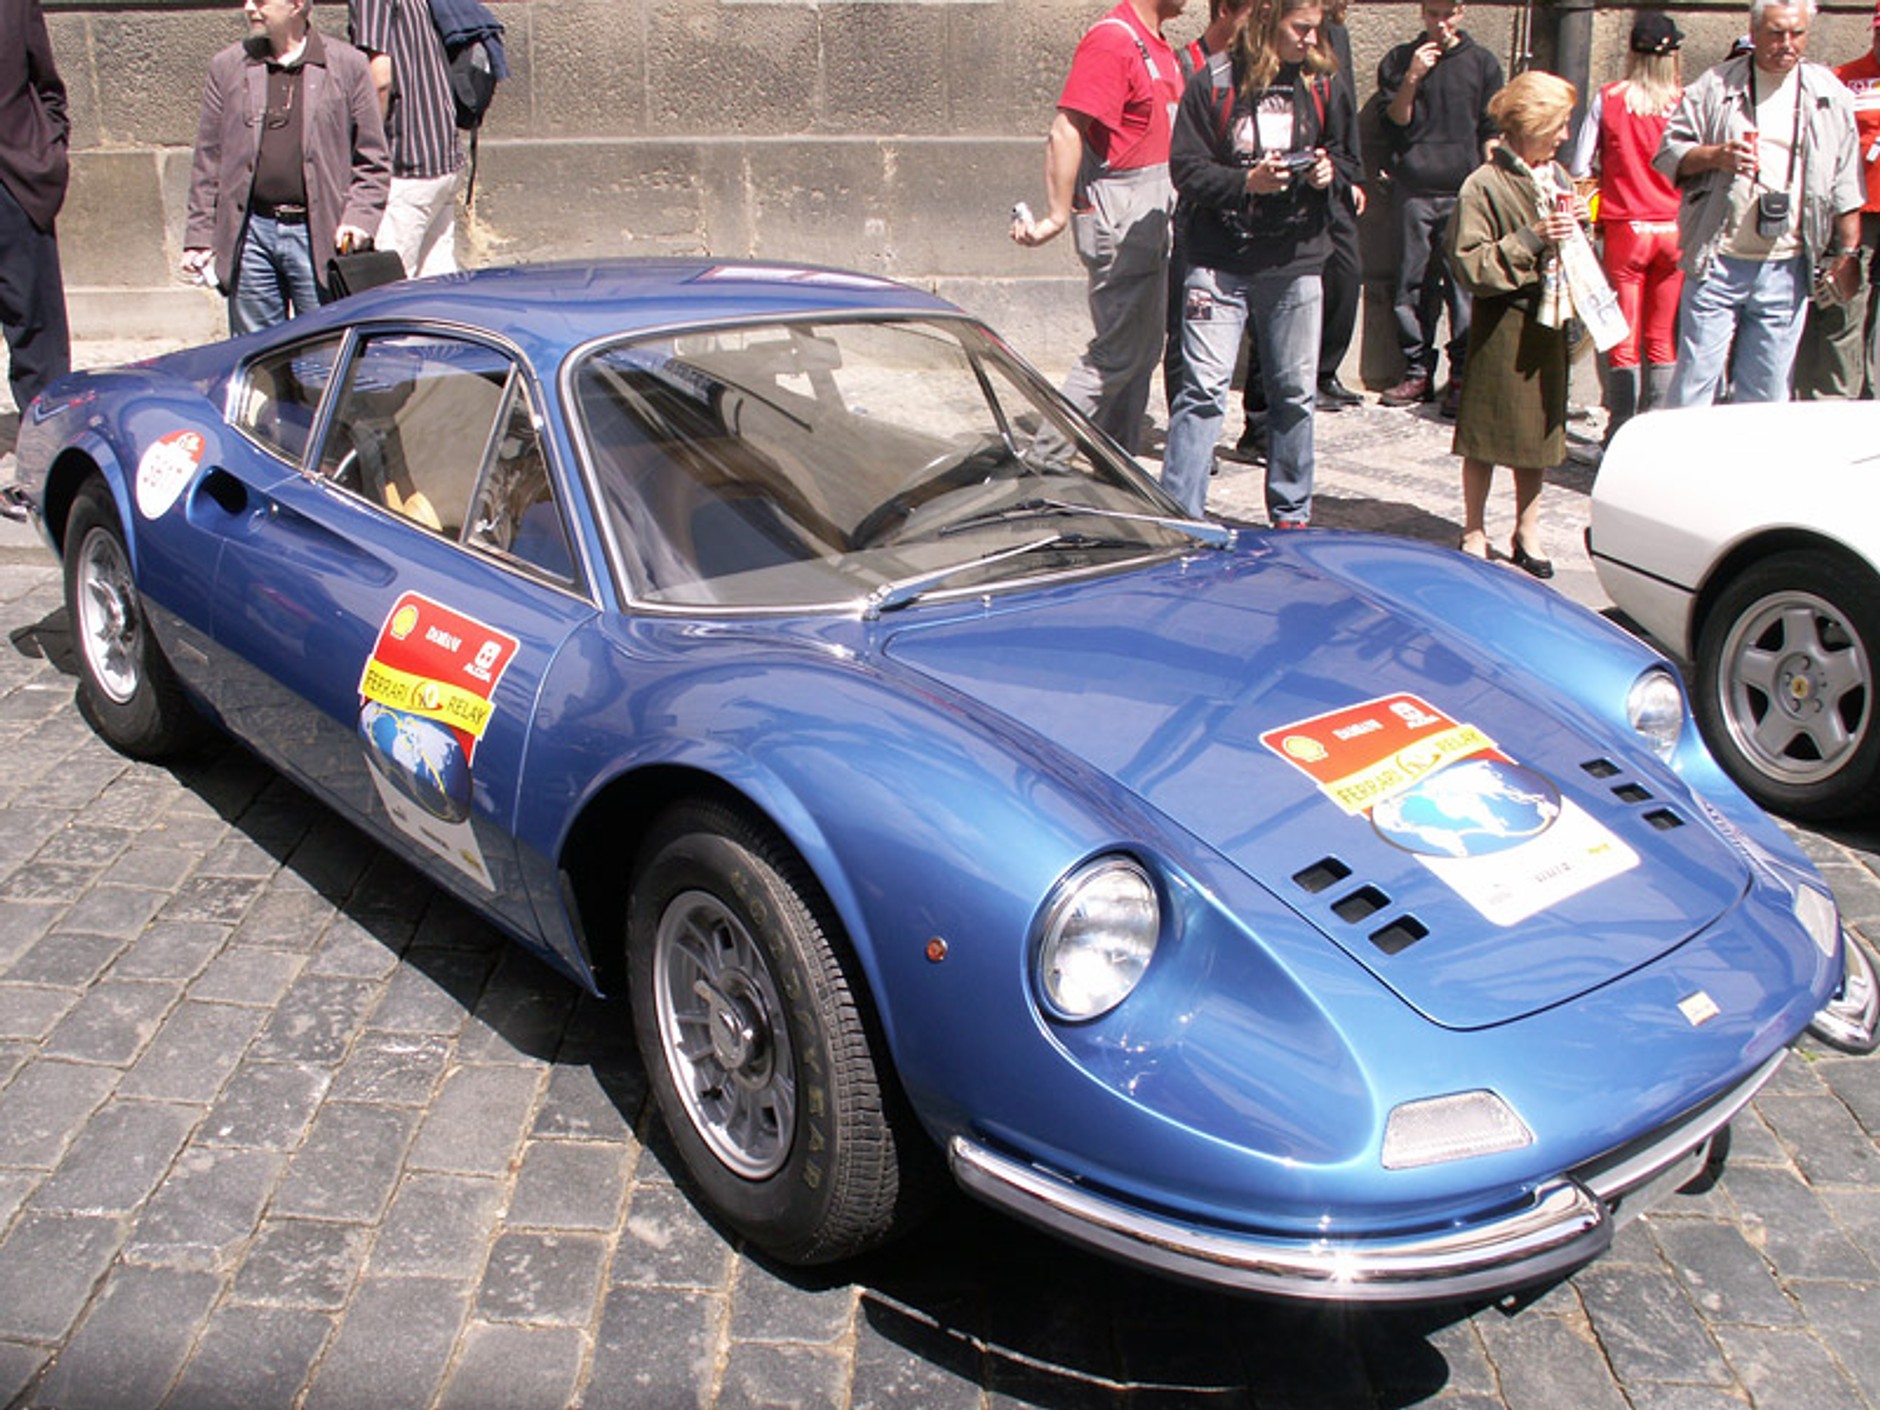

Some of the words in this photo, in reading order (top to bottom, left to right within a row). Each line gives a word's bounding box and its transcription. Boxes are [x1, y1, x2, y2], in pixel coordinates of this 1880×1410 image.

[365, 670, 408, 701] FERRARI
[447, 696, 486, 725] RELAY
[1337, 769, 1402, 804] FERRARI
